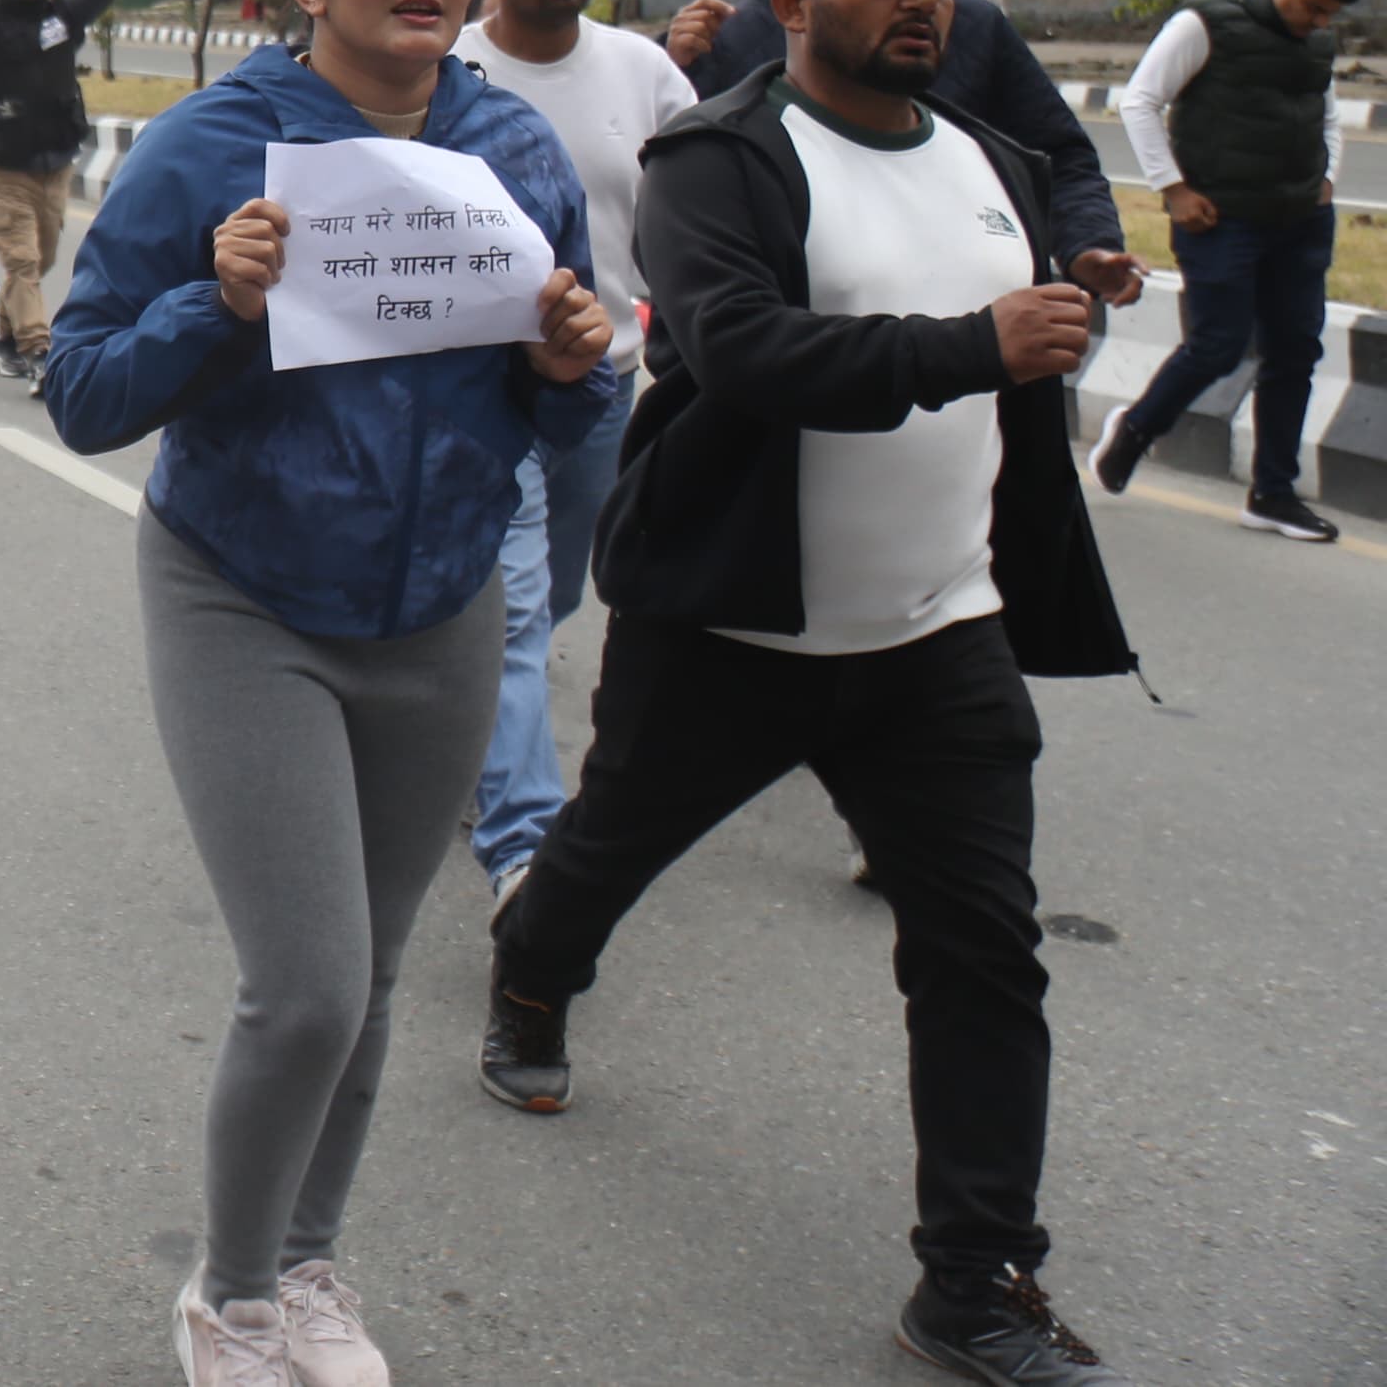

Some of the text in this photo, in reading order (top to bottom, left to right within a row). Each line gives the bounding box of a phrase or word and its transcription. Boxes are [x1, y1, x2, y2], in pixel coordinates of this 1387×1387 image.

[309, 215, 355, 235] न्याय
[365, 207, 395, 232] मरे
[404, 205, 456, 230] शक्ति
[323, 246, 512, 278] यस्तो शासन कति
[376, 294, 433, 320] टिक्छ
